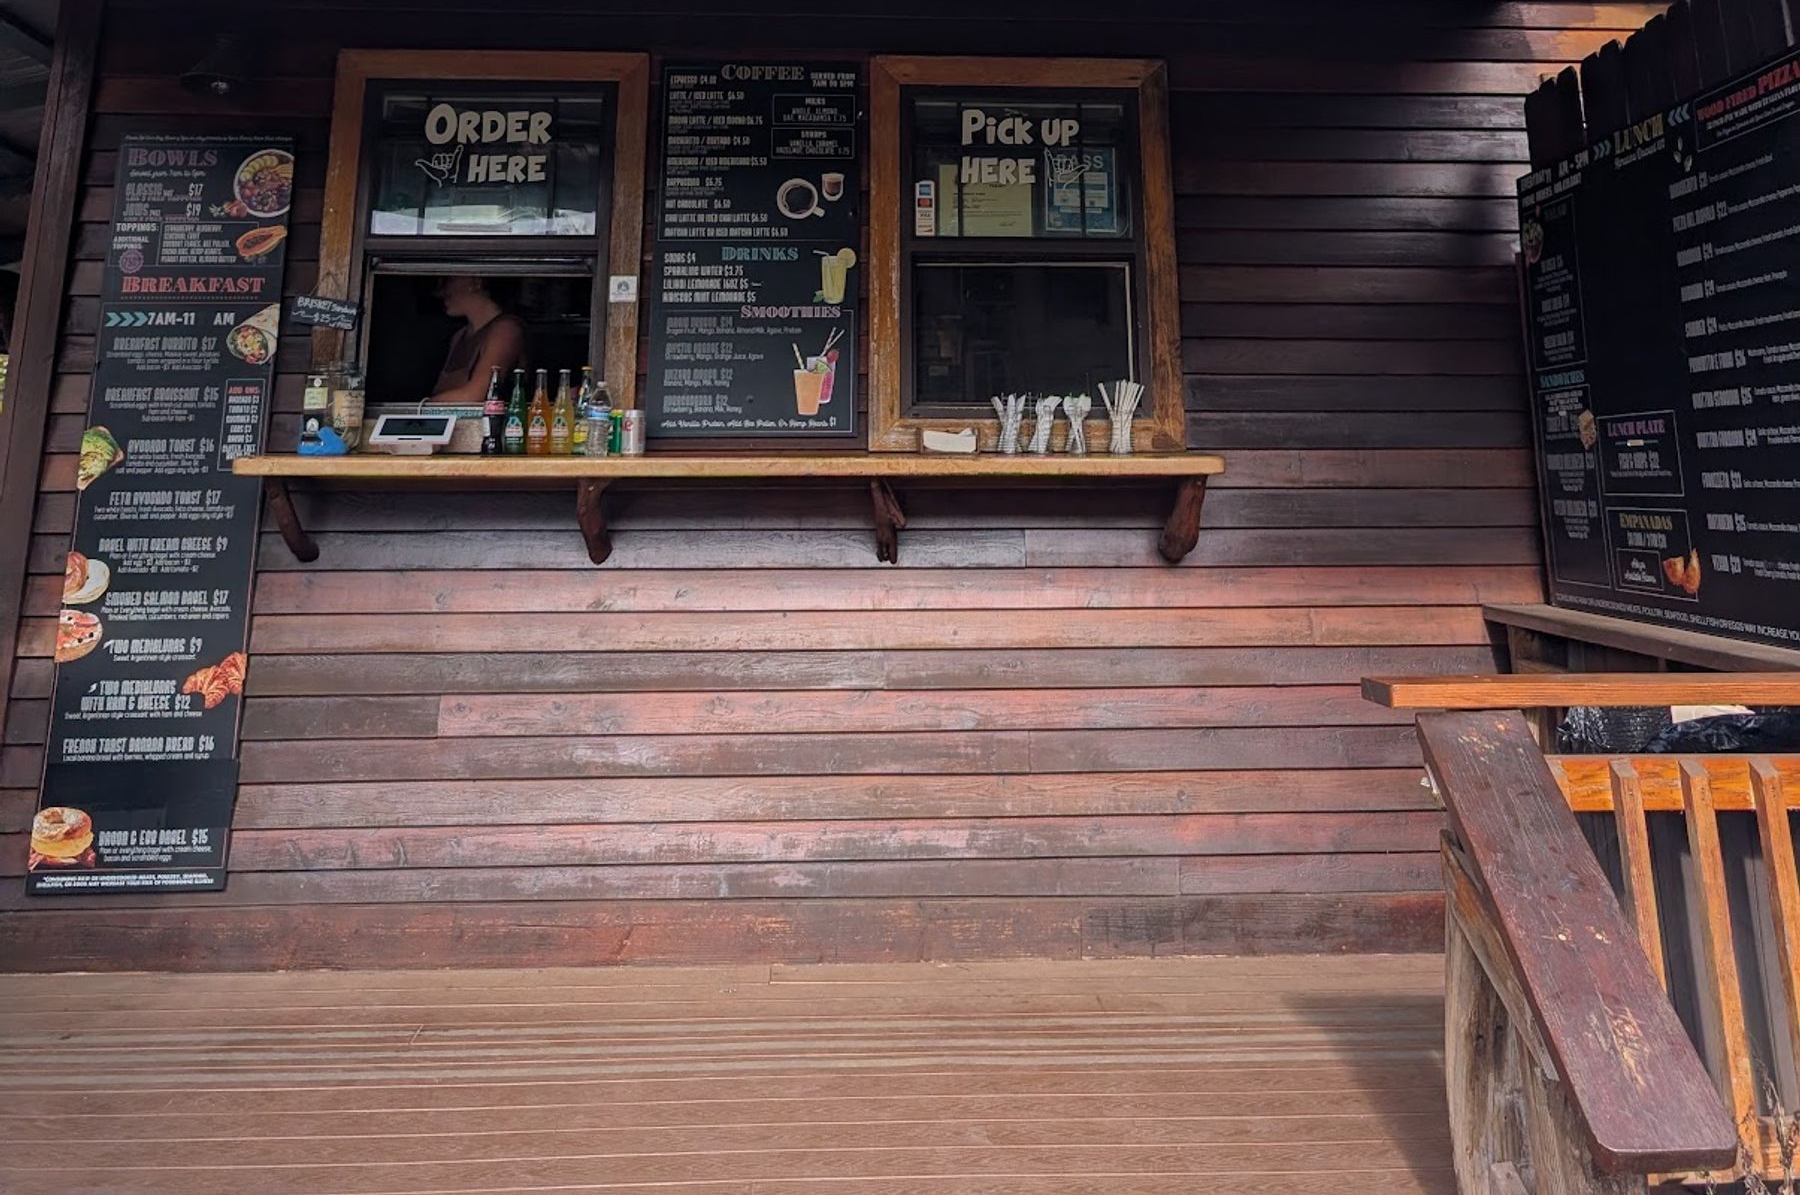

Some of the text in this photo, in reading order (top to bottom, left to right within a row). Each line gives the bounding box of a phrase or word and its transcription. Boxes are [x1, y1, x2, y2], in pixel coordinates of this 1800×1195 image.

[721, 63, 804, 81] COFFEE
[425, 103, 552, 145] ORDER
[1041, 118, 1080, 146] UP
[1613, 112, 1664, 155] LUNCH
[127, 147, 218, 166] BOWLS
[467, 155, 547, 183] HERE
[961, 156, 1036, 185] HERE
[721, 246, 799, 261] DRINKS
[121, 276, 265, 293] BREAKFAST
[213, 312, 236, 325] AM
[741, 305, 841, 318] SMOOTHIES
[201, 335, 218, 352] $17
[204, 385, 220, 402] $15
[168, 439, 195, 453] TOAST
[199, 437, 215, 454] $16
[109, 490, 132, 505] FETA
[174, 490, 201, 505] TOAST
[205, 489, 222, 507] $17
[1619, 512, 1673, 530] EMPANADAS
[181, 537, 213, 552] CHEESE
[215, 536, 228, 553] $9
[213, 588, 230, 606] $17
[189, 636, 203, 654] $9
[138, 696, 171, 711] CHEESE
[174, 694, 191, 711] $12
[62, 737, 97, 753] FRENCH
[98, 737, 126, 753] TOAST
[198, 735, 215, 753] $16
[191, 827, 209, 846] $15
